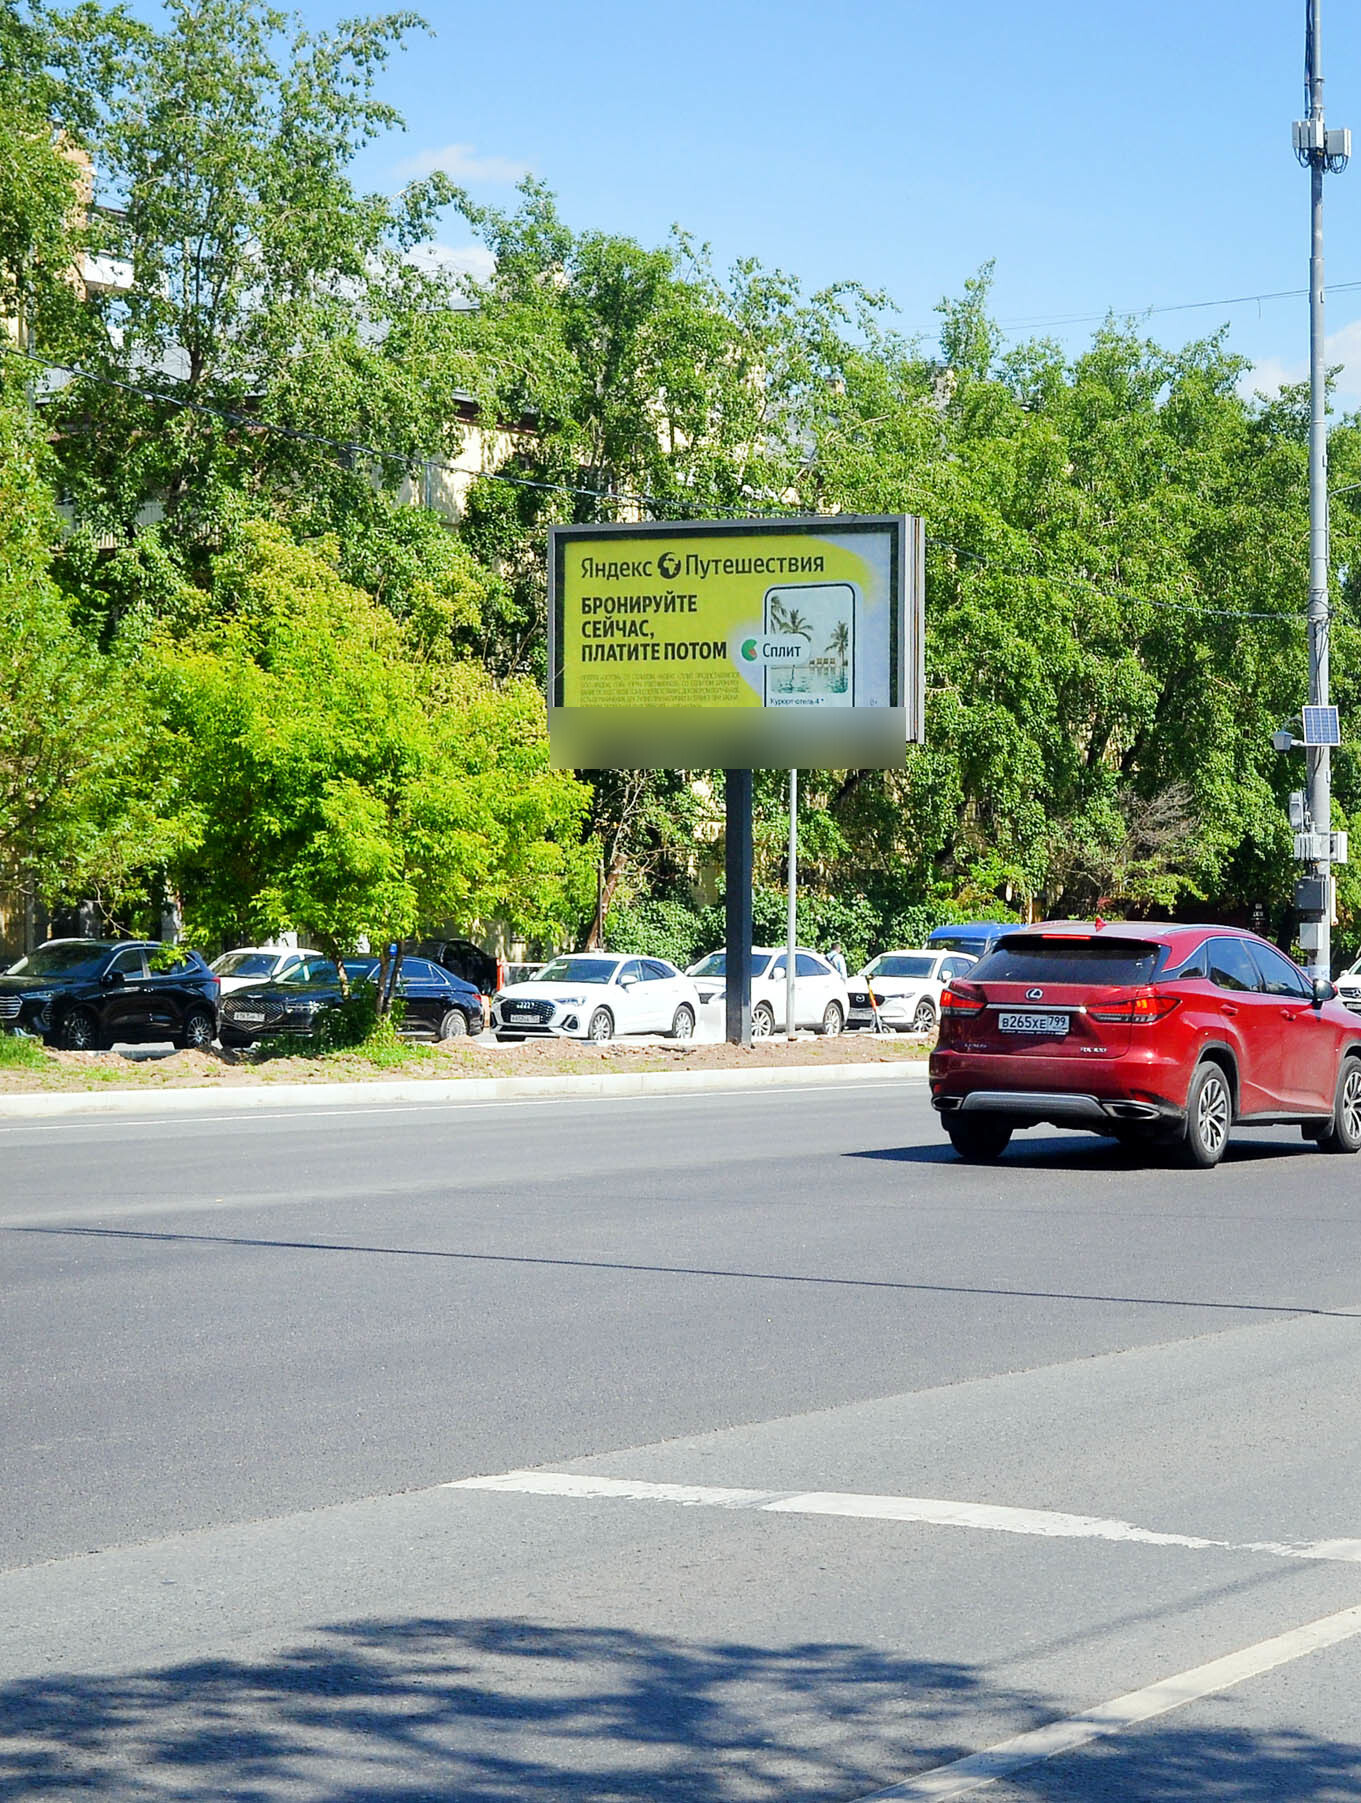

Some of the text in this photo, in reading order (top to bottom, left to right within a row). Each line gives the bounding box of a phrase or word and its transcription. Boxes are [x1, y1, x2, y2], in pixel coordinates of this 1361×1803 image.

[581, 555, 825, 581] Яндекс Путешествия
[581, 591, 697, 615] БРОНИРУЙТЕ
[581, 616, 655, 641] СЕЙЧАС,
[581, 640, 728, 663] ПЛАТИТЕ ПОТОМ
[762, 643, 802, 659] Сплит
[1002, 1015, 1067, 1029] В265ХЕ 799
